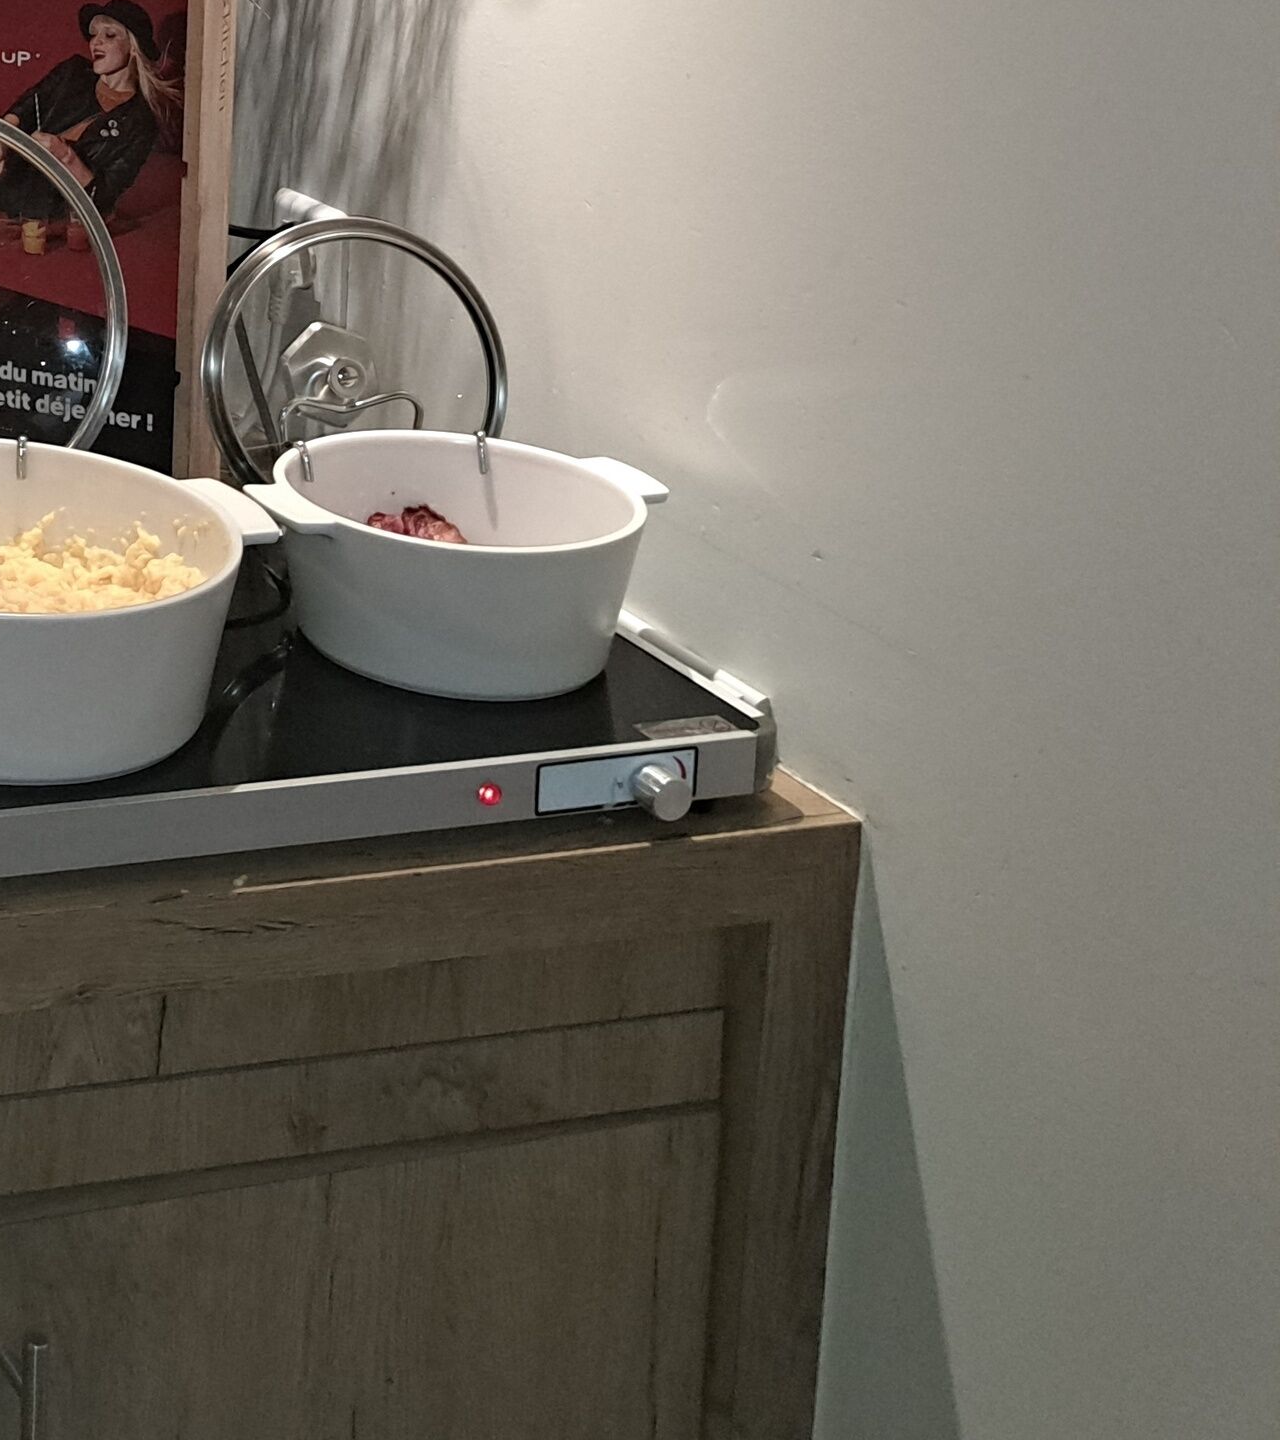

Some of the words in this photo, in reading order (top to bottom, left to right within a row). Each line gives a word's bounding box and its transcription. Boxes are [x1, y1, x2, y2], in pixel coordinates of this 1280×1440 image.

[0, 361, 27, 383] du
[32, 370, 98, 393] matin
[146, 413, 153, 432] !
